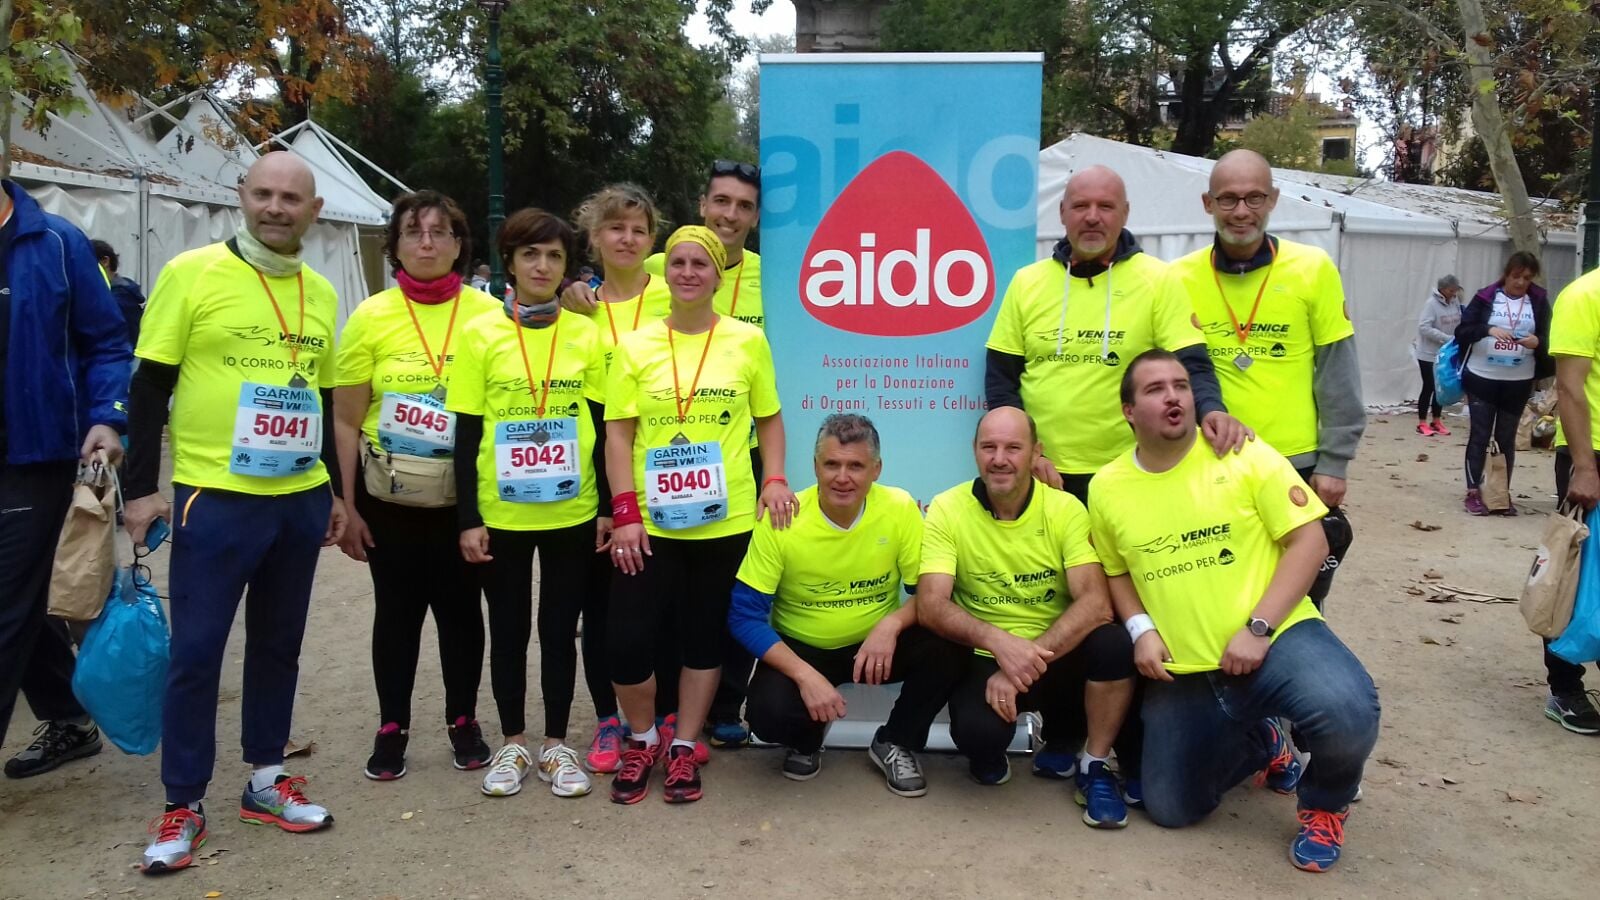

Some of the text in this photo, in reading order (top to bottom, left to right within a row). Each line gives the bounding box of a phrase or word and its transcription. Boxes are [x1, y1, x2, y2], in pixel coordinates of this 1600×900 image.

[760, 103, 1040, 230] aio
[806, 228, 988, 307] aido
[1083, 354, 1102, 363] PER
[1248, 347, 1268, 356] PER
[240, 358, 285, 370] CORRO
[822, 353, 969, 368] Associazione Italiana
[837, 374, 955, 391] per la Donazione
[254, 386, 314, 401] GARMIN
[550, 406, 568, 416] PER
[802, 394, 989, 412] di Organi, Tessuti e Cellule
[394, 402, 449, 432] 5045
[699, 414, 717, 424] PER
[253, 413, 309, 439] 5041
[506, 420, 564, 433] GARMIN
[511, 444, 566, 467] 5042
[654, 445, 708, 459] GARMIN
[658, 469, 711, 493] 5040
[1181, 523, 1231, 542] VENICE
[1182, 533, 1232, 550] MARATHON
[1156, 561, 1194, 579] CORRO
[1196, 556, 1217, 569] PER
[982, 595, 1021, 605] CORRO
[1024, 596, 1042, 606] PER
